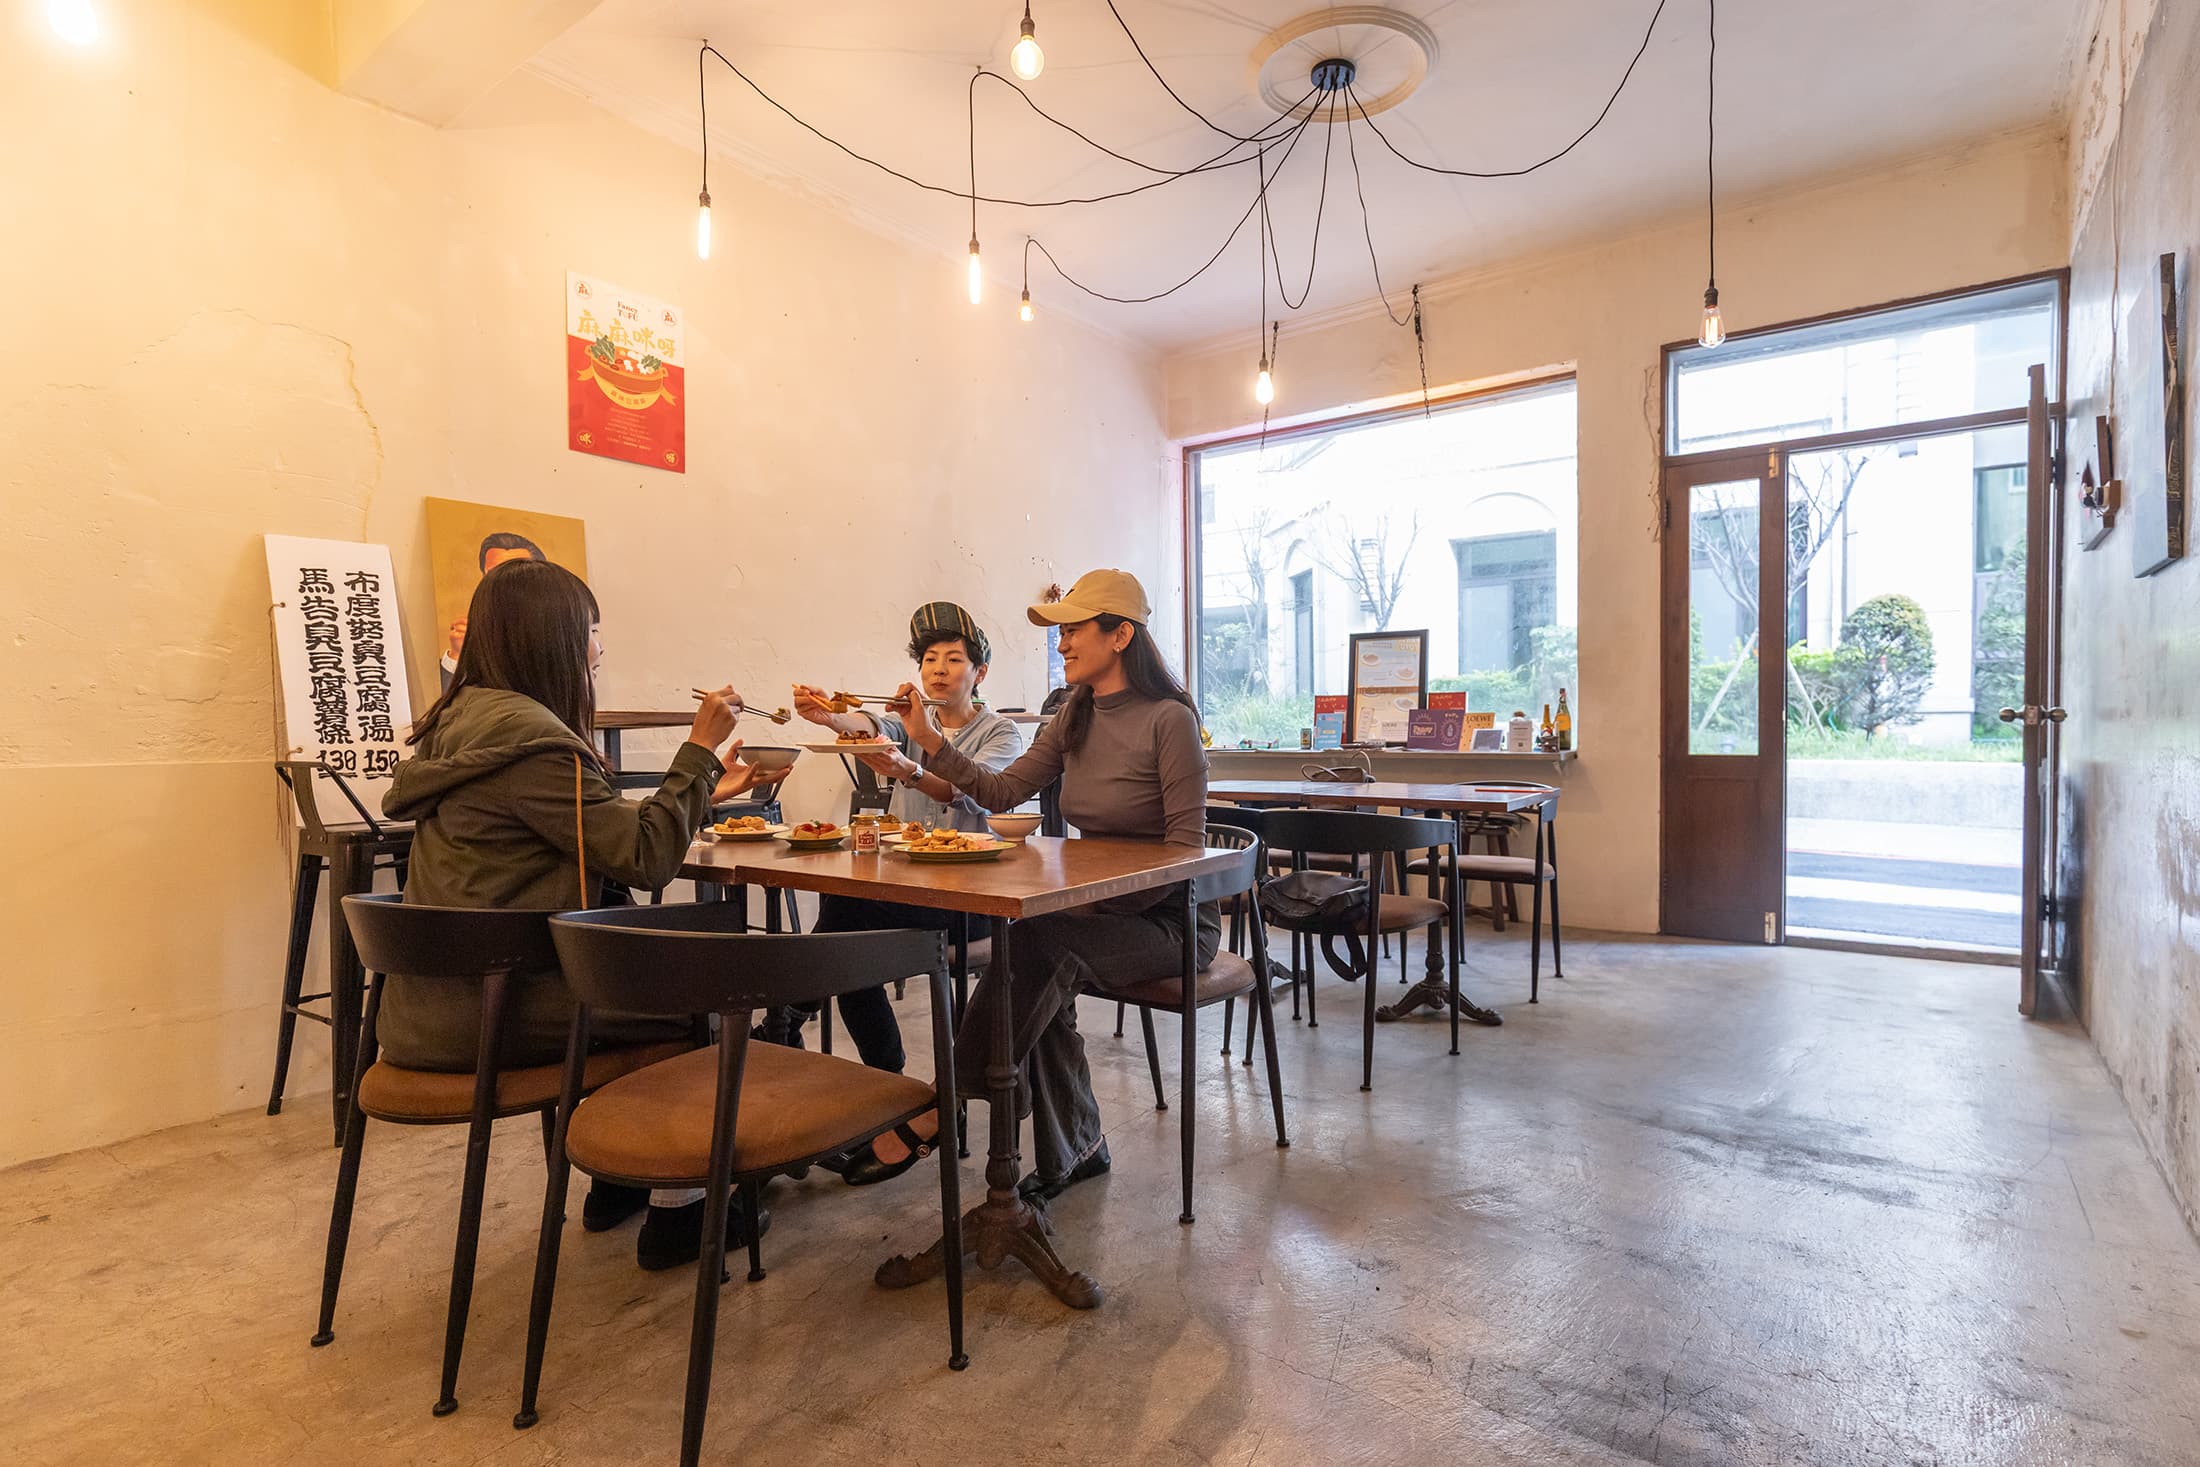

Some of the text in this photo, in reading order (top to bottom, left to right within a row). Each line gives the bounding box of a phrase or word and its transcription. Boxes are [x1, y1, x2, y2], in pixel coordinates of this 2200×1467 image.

[577, 309, 676, 359] 麻麻咪呀
[316, 749, 357, 771] 130
[362, 749, 400, 772] 150
